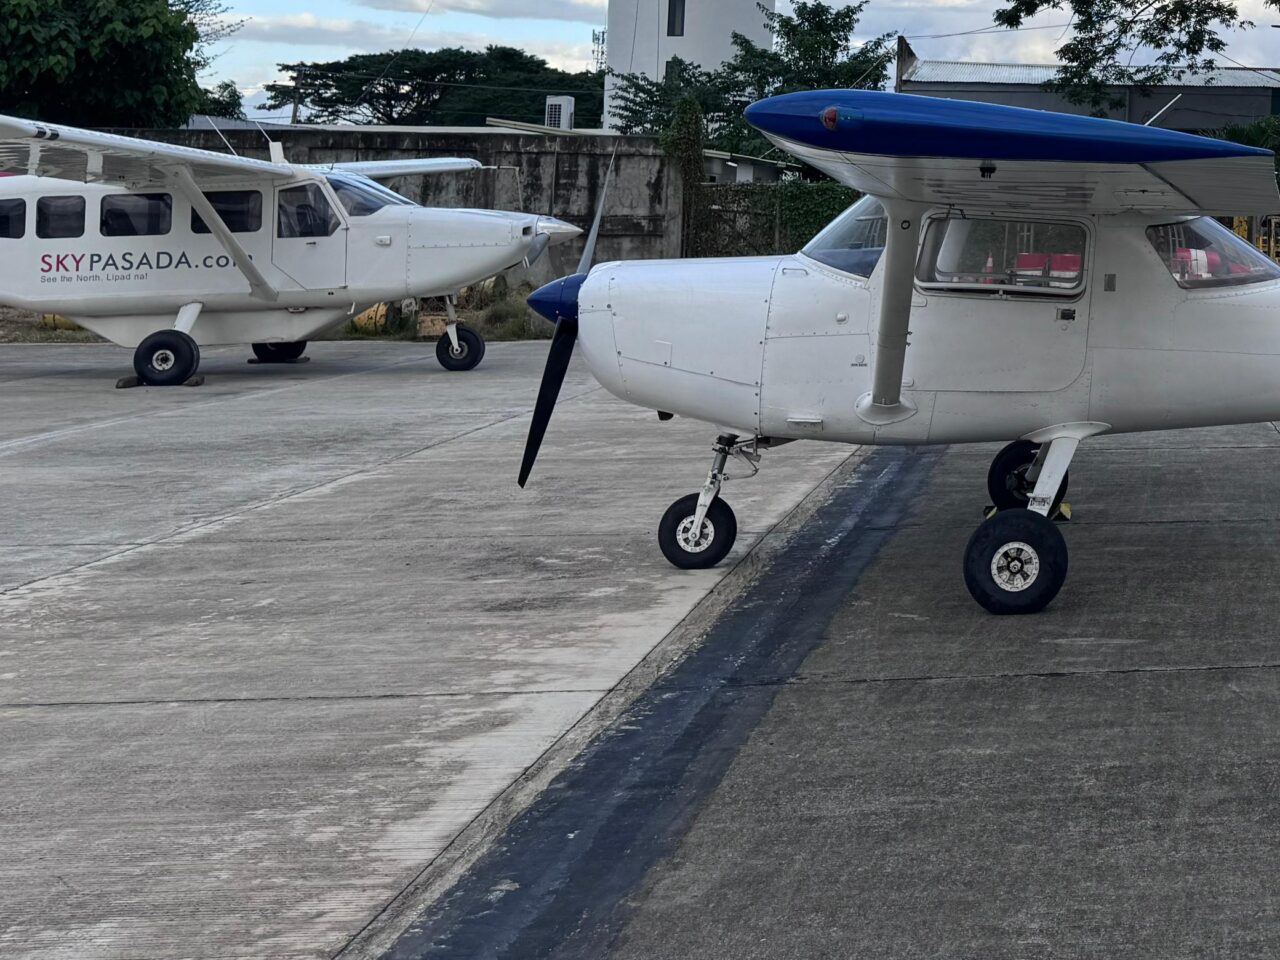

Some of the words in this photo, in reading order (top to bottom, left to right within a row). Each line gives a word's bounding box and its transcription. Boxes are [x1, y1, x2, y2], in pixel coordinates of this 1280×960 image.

[40, 275, 57, 283] See
[60, 274, 73, 282] the
[106, 273, 131, 282] Lipad
